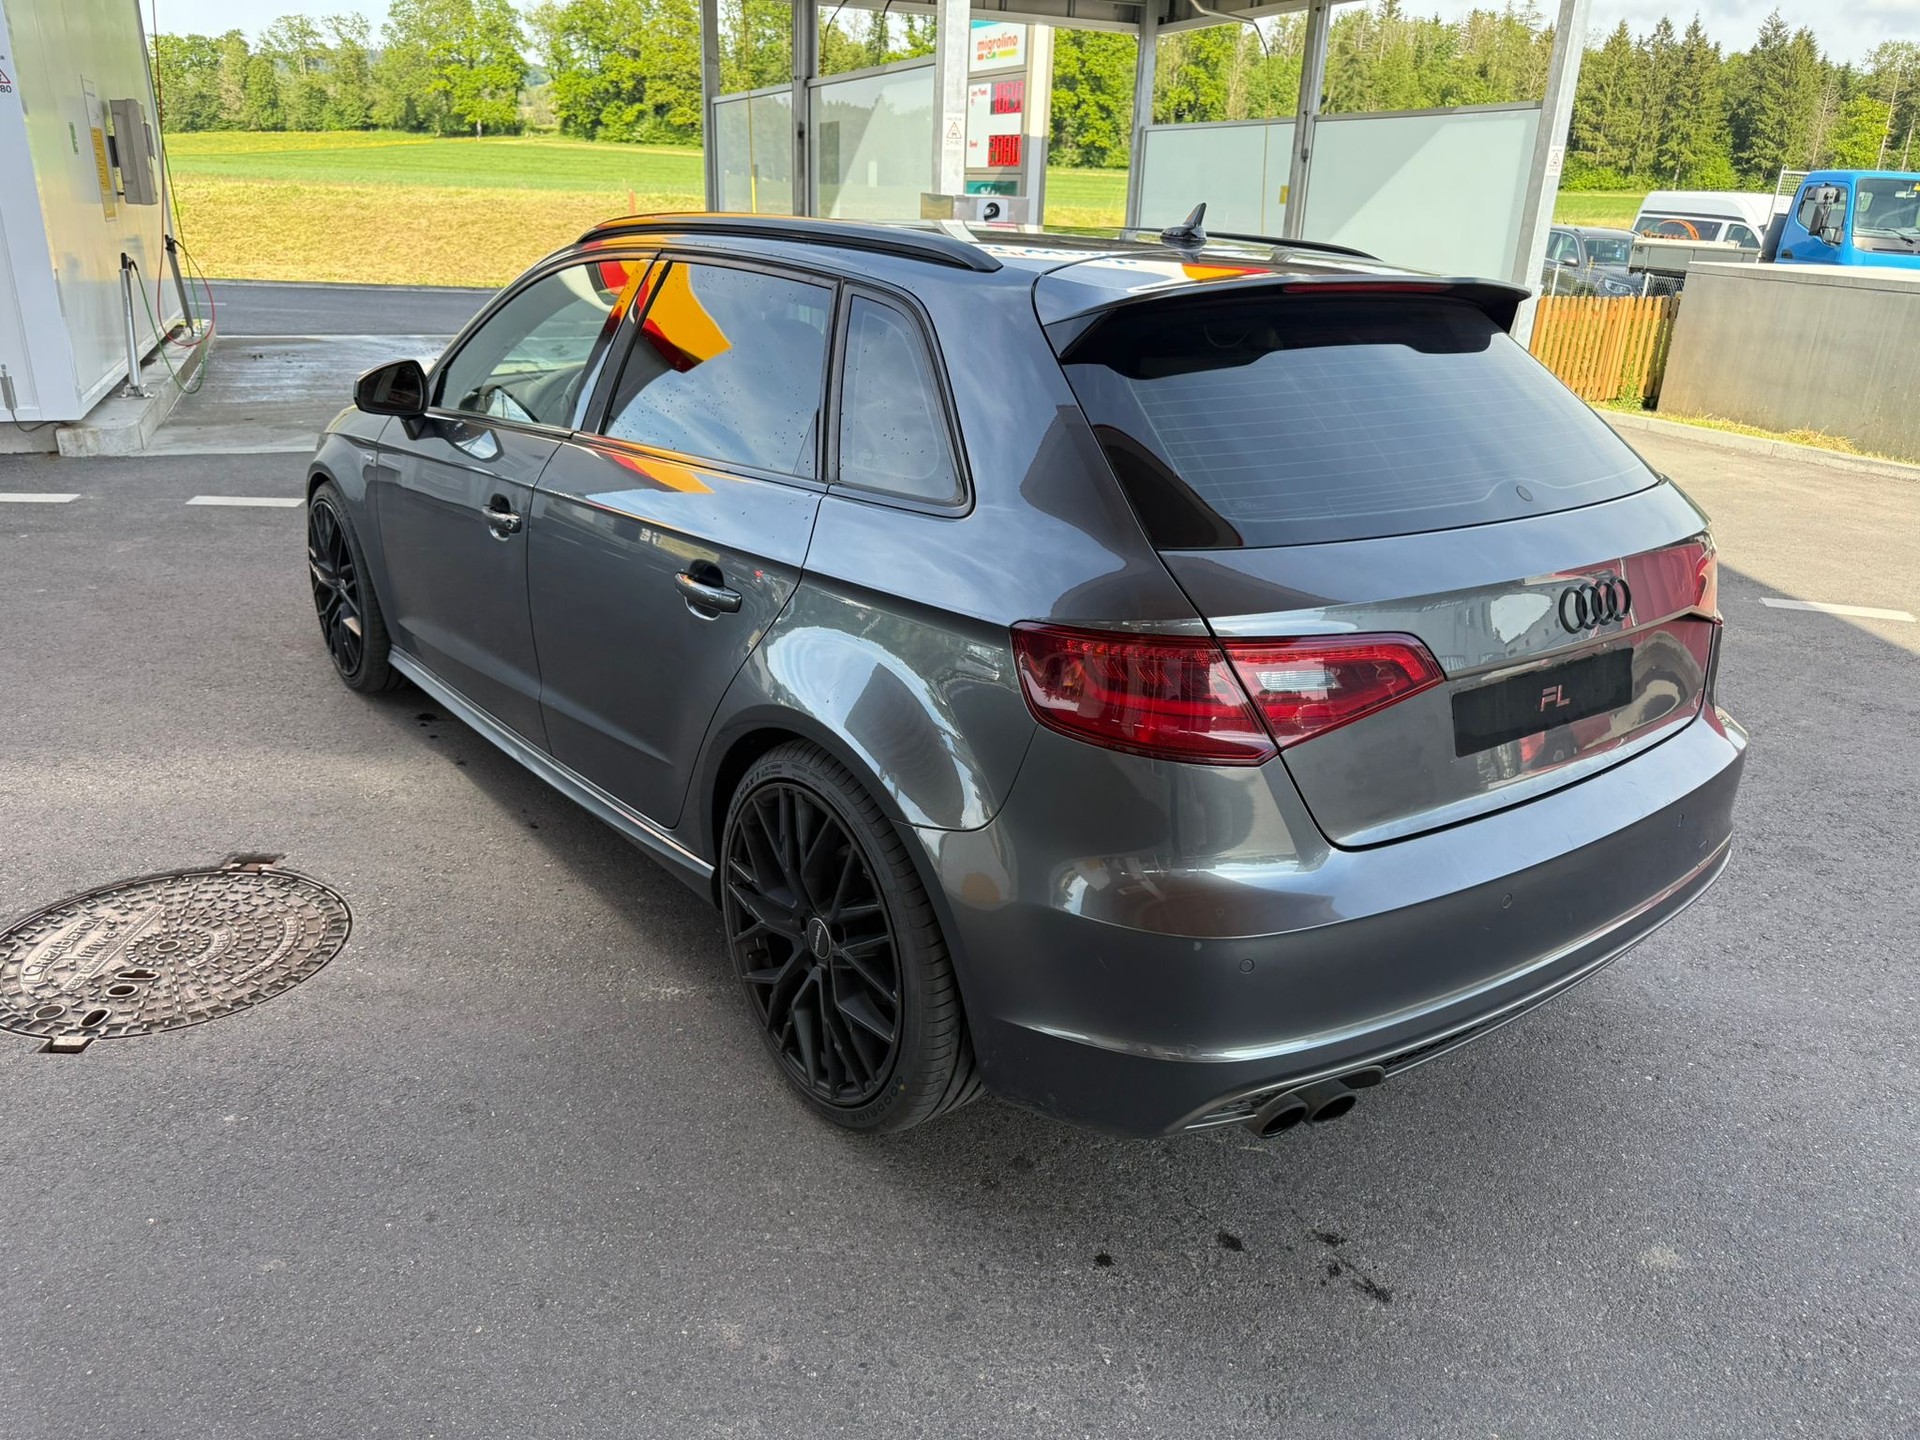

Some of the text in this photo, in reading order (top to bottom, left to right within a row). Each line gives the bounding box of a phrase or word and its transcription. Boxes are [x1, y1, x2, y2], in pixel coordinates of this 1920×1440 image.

[977, 32, 1018, 55] migrolino
[0, 84, 12, 93] 80
[988, 135, 1022, 167] 2080
[1539, 684, 1571, 713] FL
